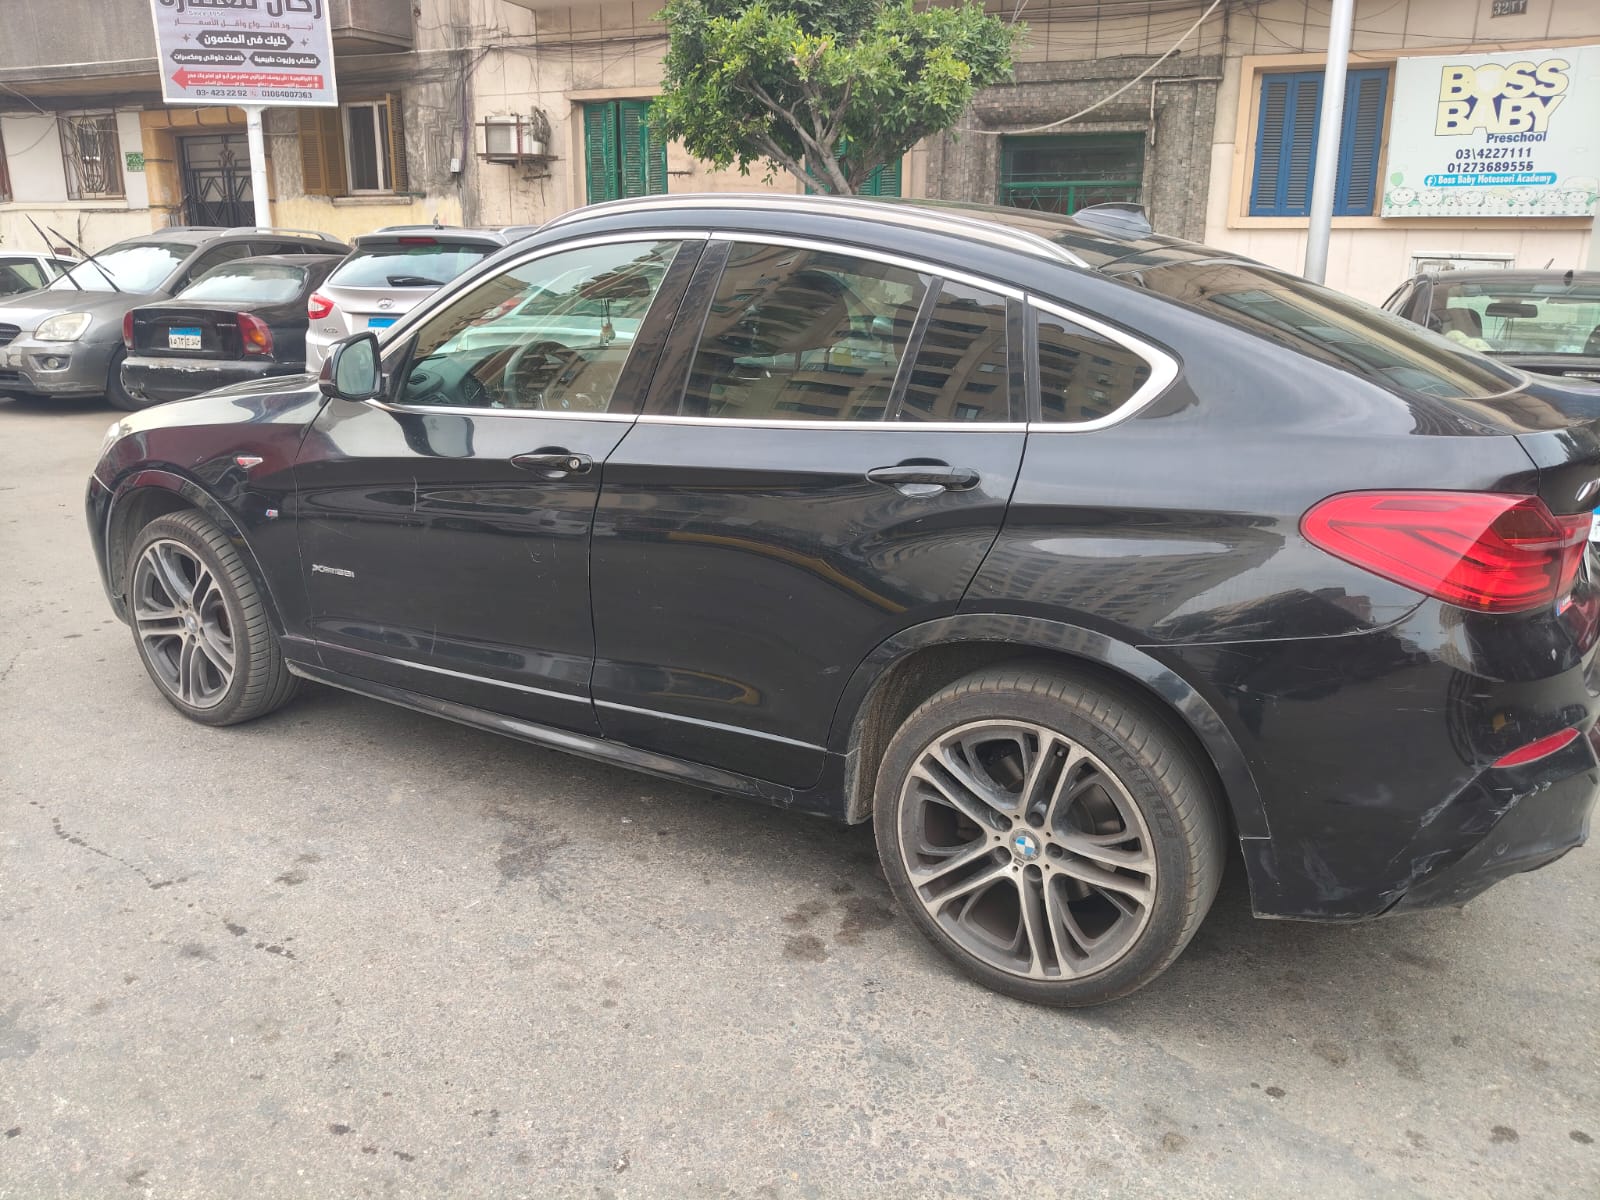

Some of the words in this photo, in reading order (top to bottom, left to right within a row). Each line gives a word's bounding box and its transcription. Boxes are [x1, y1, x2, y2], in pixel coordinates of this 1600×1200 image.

[204, 33, 245, 45] المضمون
[265, 35, 287, 46] خليك
[1439, 58, 1571, 102] BOSS
[1435, 94, 1567, 136] BABY
[1486, 132, 1548, 144] Preschool
[1455, 147, 1532, 160] 03\4227111
[1438, 175, 1457, 184] Boss
[1457, 174, 1476, 186] Baby
[1516, 173, 1551, 184] Academy
